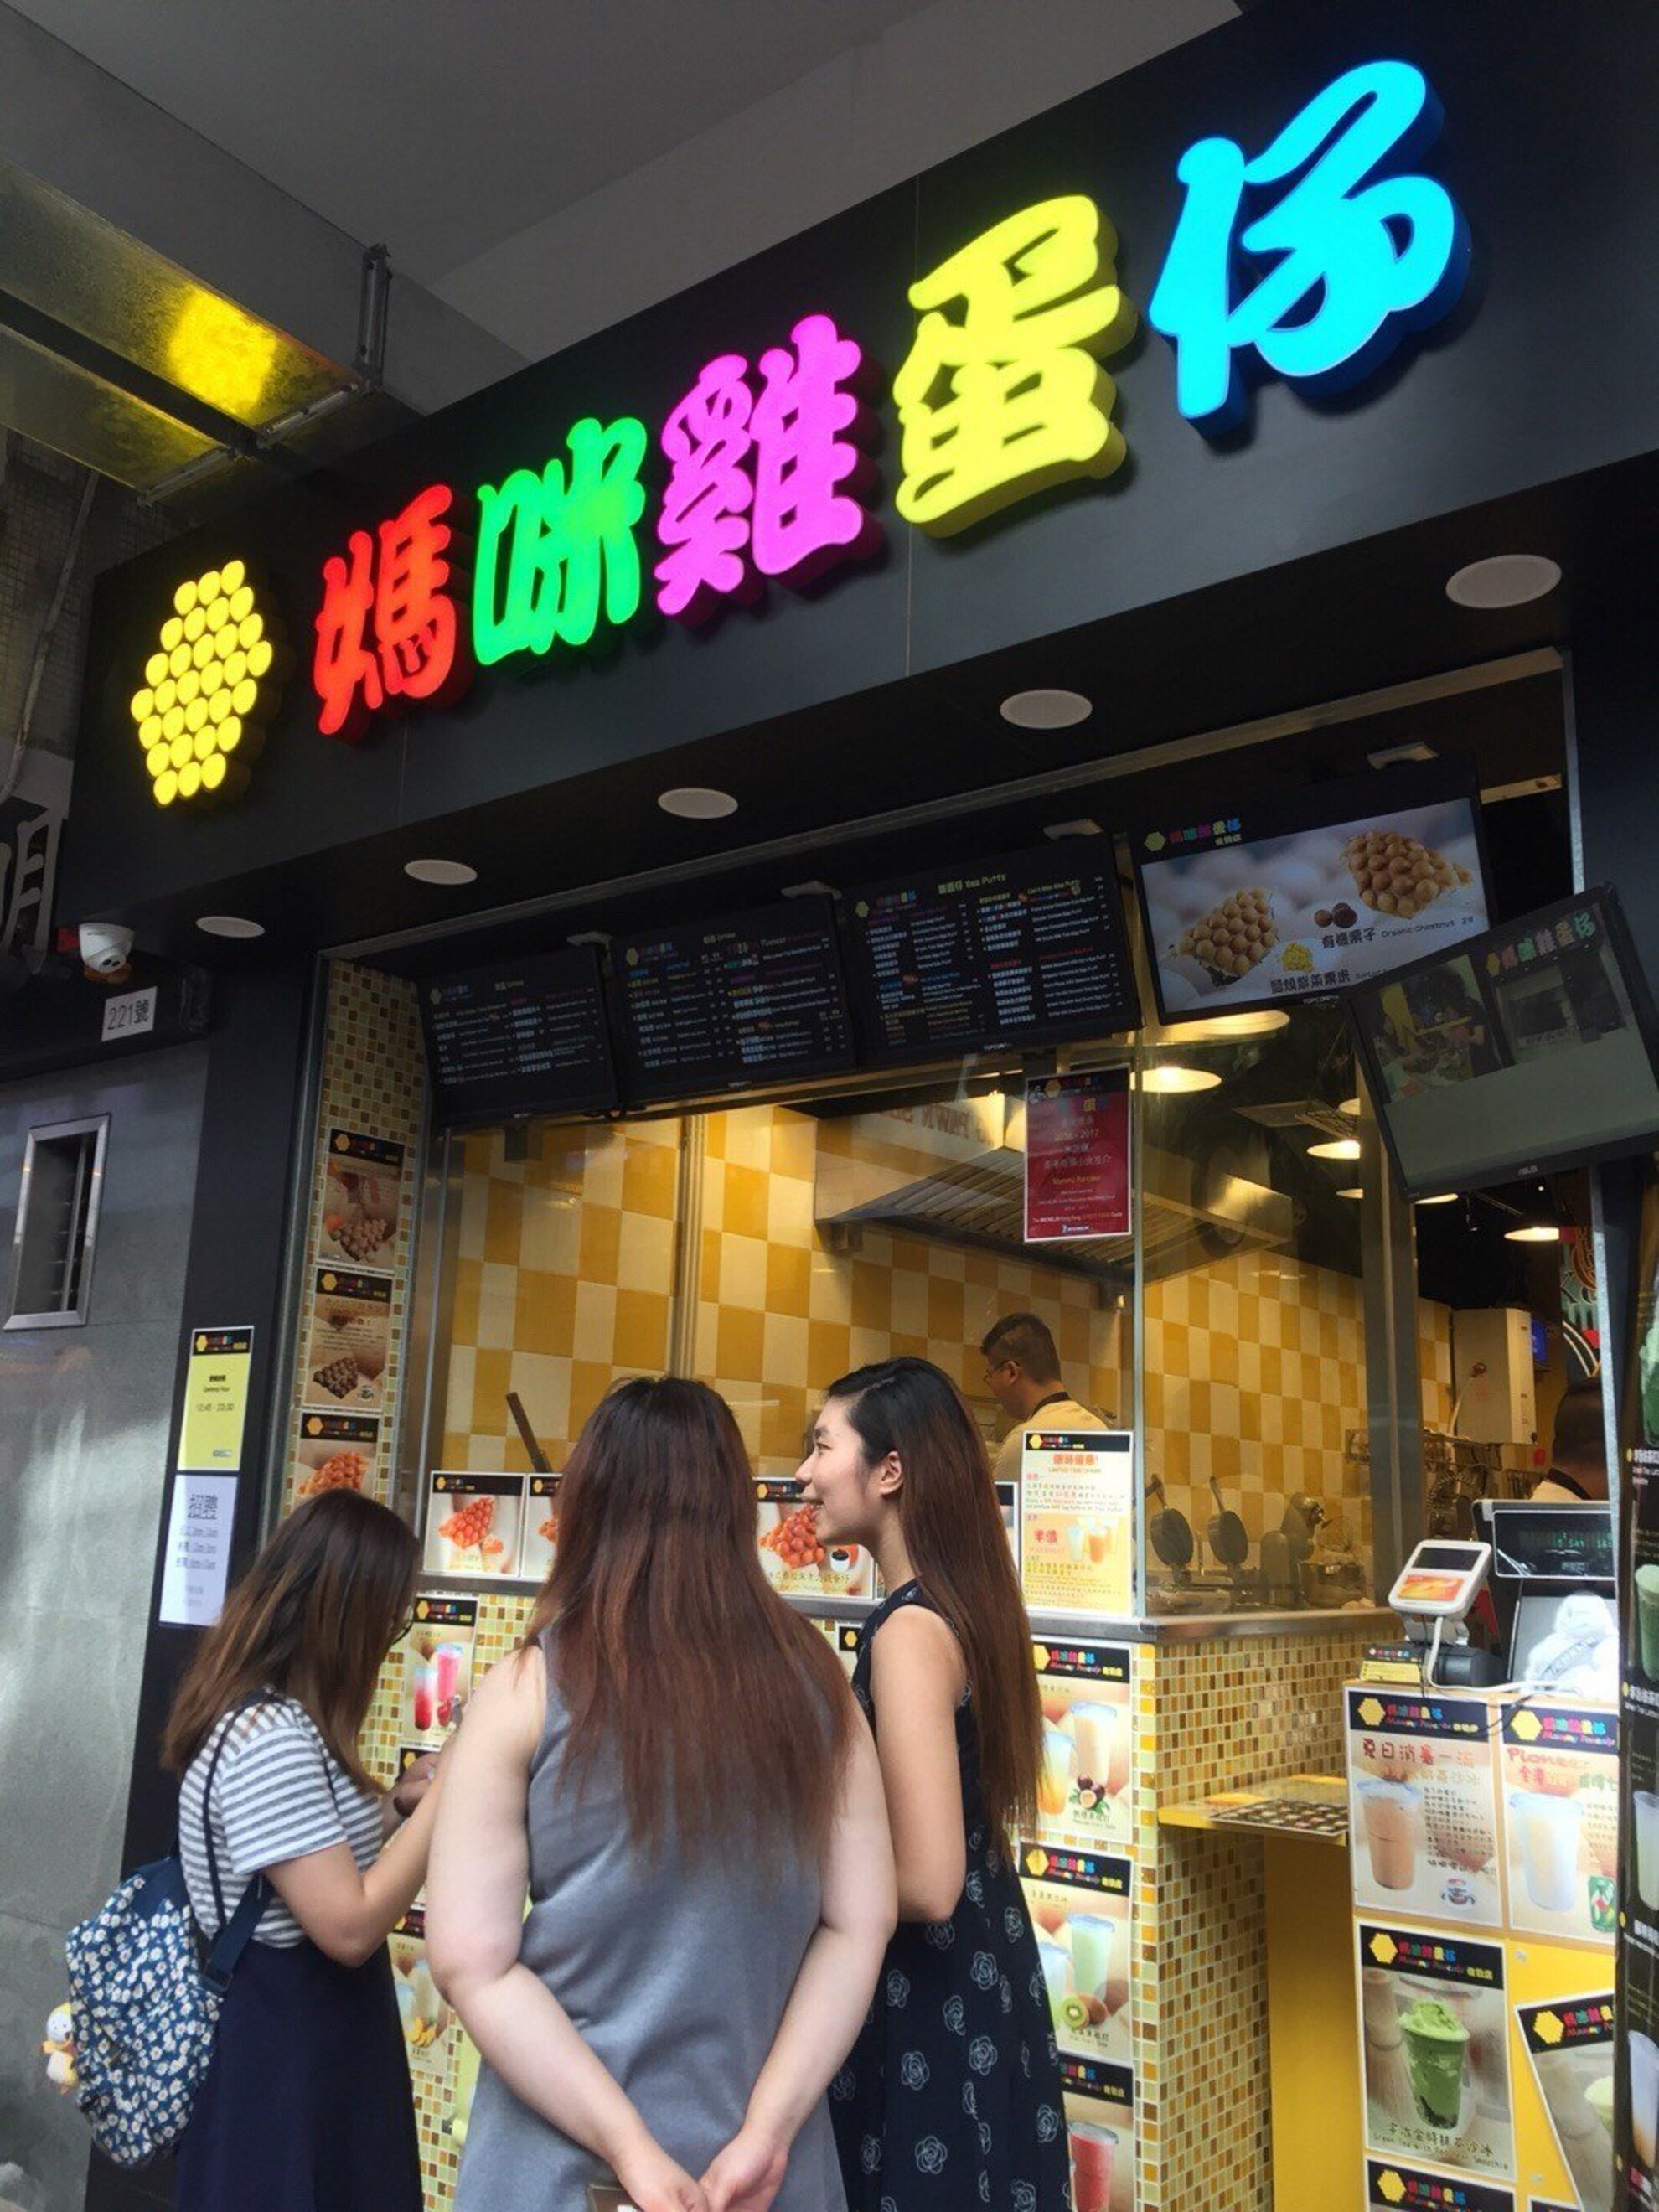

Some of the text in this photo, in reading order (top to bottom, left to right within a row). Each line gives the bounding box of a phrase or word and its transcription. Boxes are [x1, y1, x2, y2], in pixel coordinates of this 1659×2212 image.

[313, 60, 1458, 737] 媽咪雞蛋仔
[107, 999, 149, 1031] 221號
